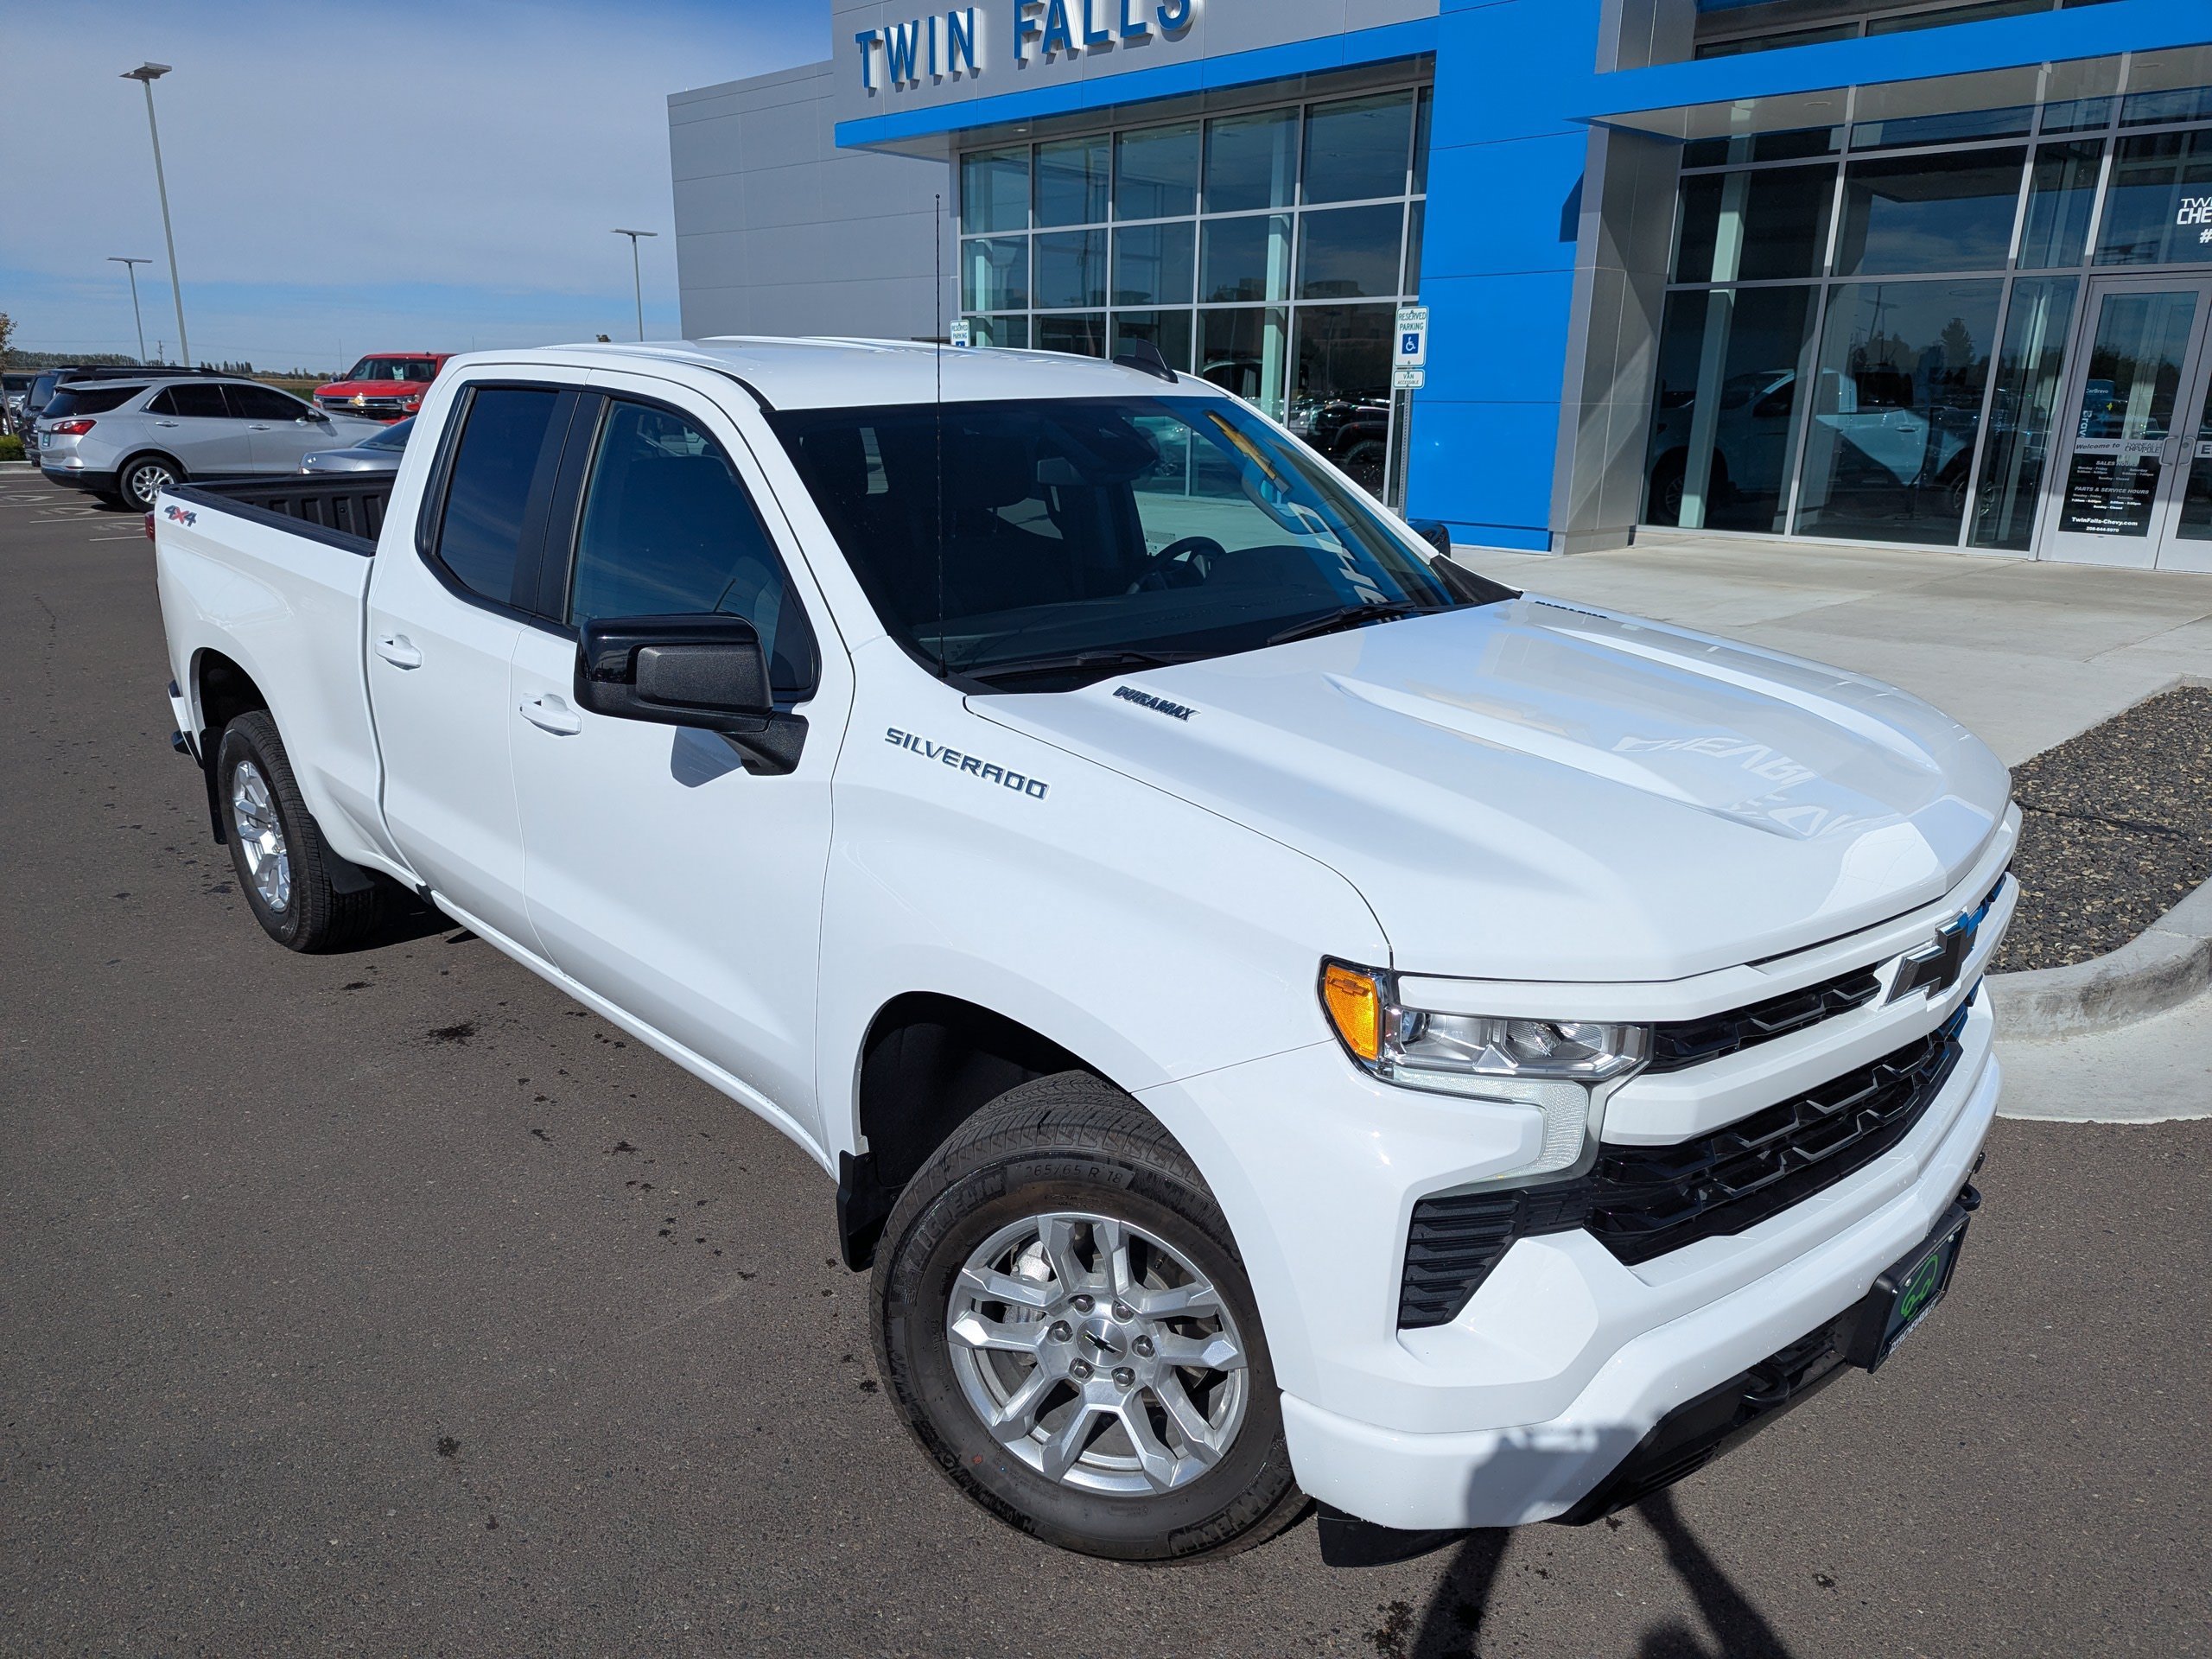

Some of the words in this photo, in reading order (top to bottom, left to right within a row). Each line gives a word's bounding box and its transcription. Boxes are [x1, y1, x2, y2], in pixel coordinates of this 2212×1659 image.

[855, 7, 980, 89] TWIN
[2181, 197, 2212, 208] TW
[1398, 312, 1427, 321] RESERVED
[1400, 322, 1424, 331] PARKING
[2080, 410, 2093, 438] Brav
[2125, 445, 2162, 454] CHEVROLE
[2071, 517, 2139, 526] TwinFalls-Chevy.com
[1112, 685, 1200, 722] DURAMAX
[885, 727, 1051, 800] SILVERADO
[1088, 1166, 1100, 1179] R
[1107, 1170, 1123, 1184] 18
